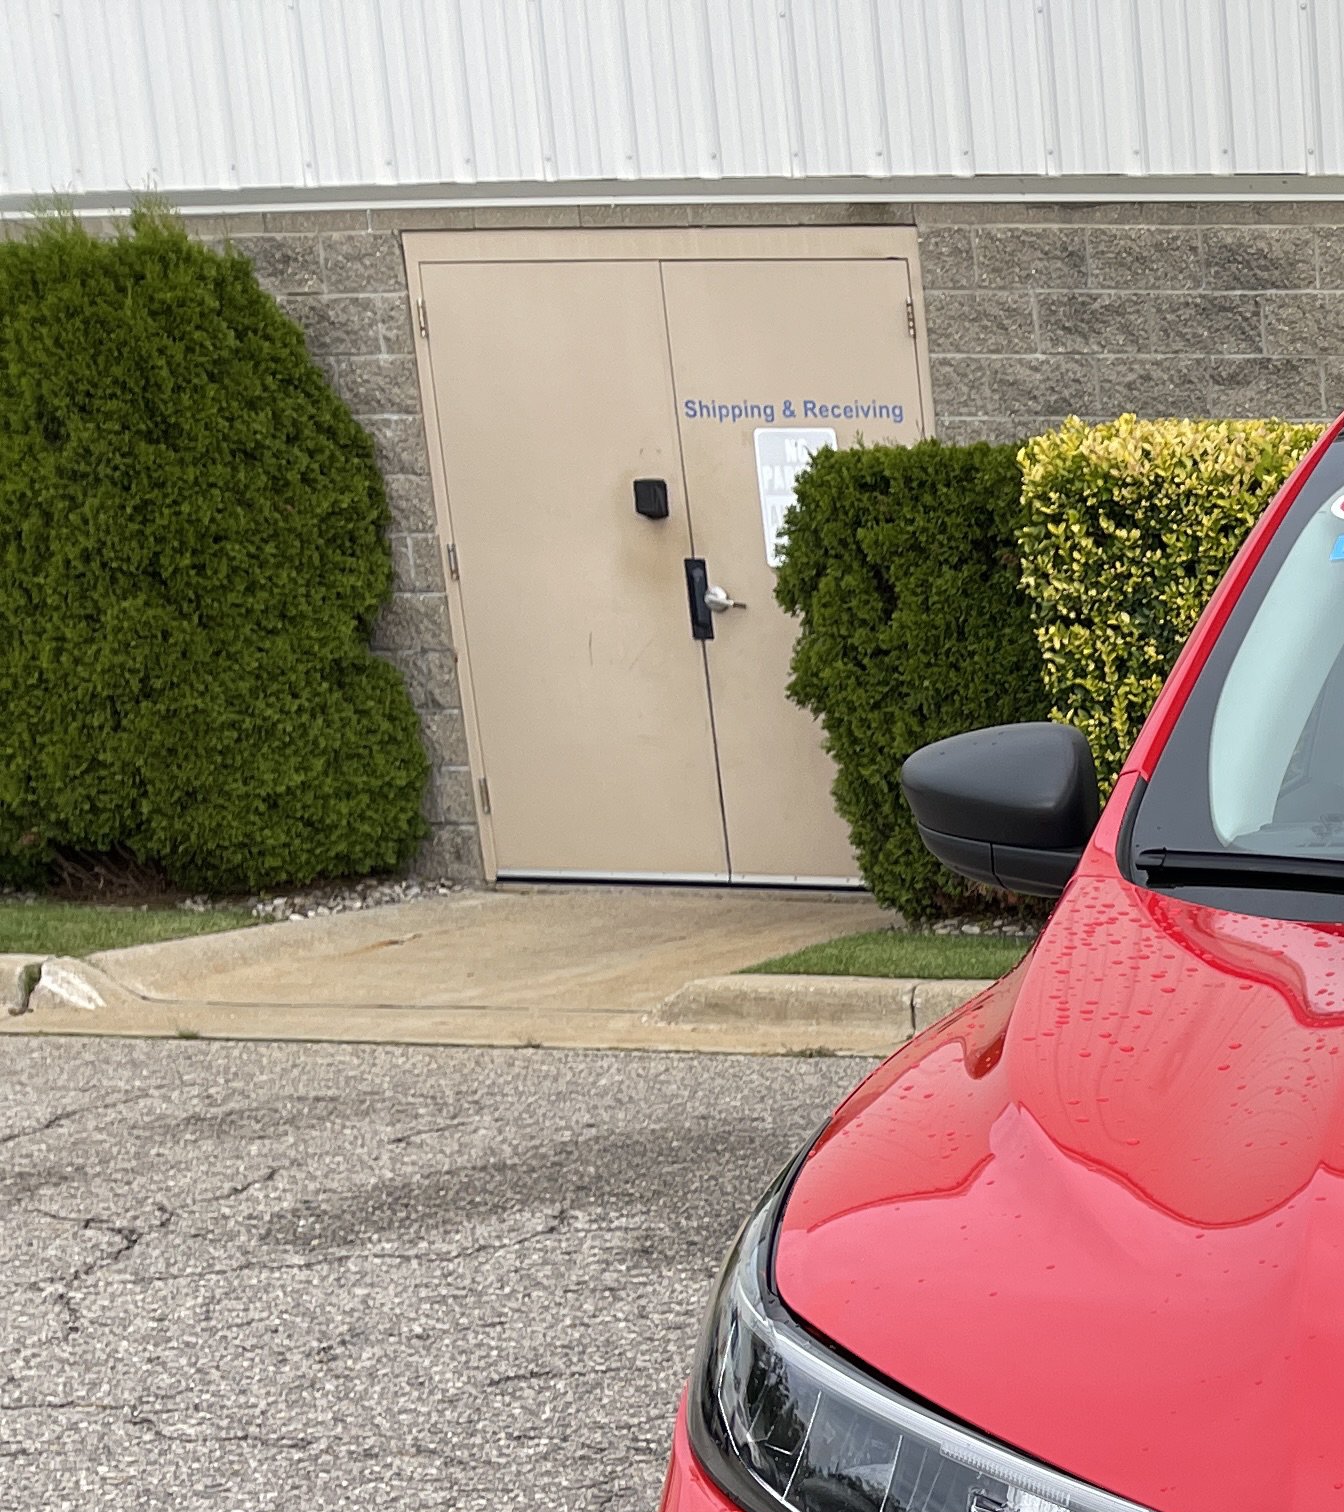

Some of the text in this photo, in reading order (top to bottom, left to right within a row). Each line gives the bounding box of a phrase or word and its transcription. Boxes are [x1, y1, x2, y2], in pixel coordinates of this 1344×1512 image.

[684, 399, 905, 423] Shipping & Receiving
